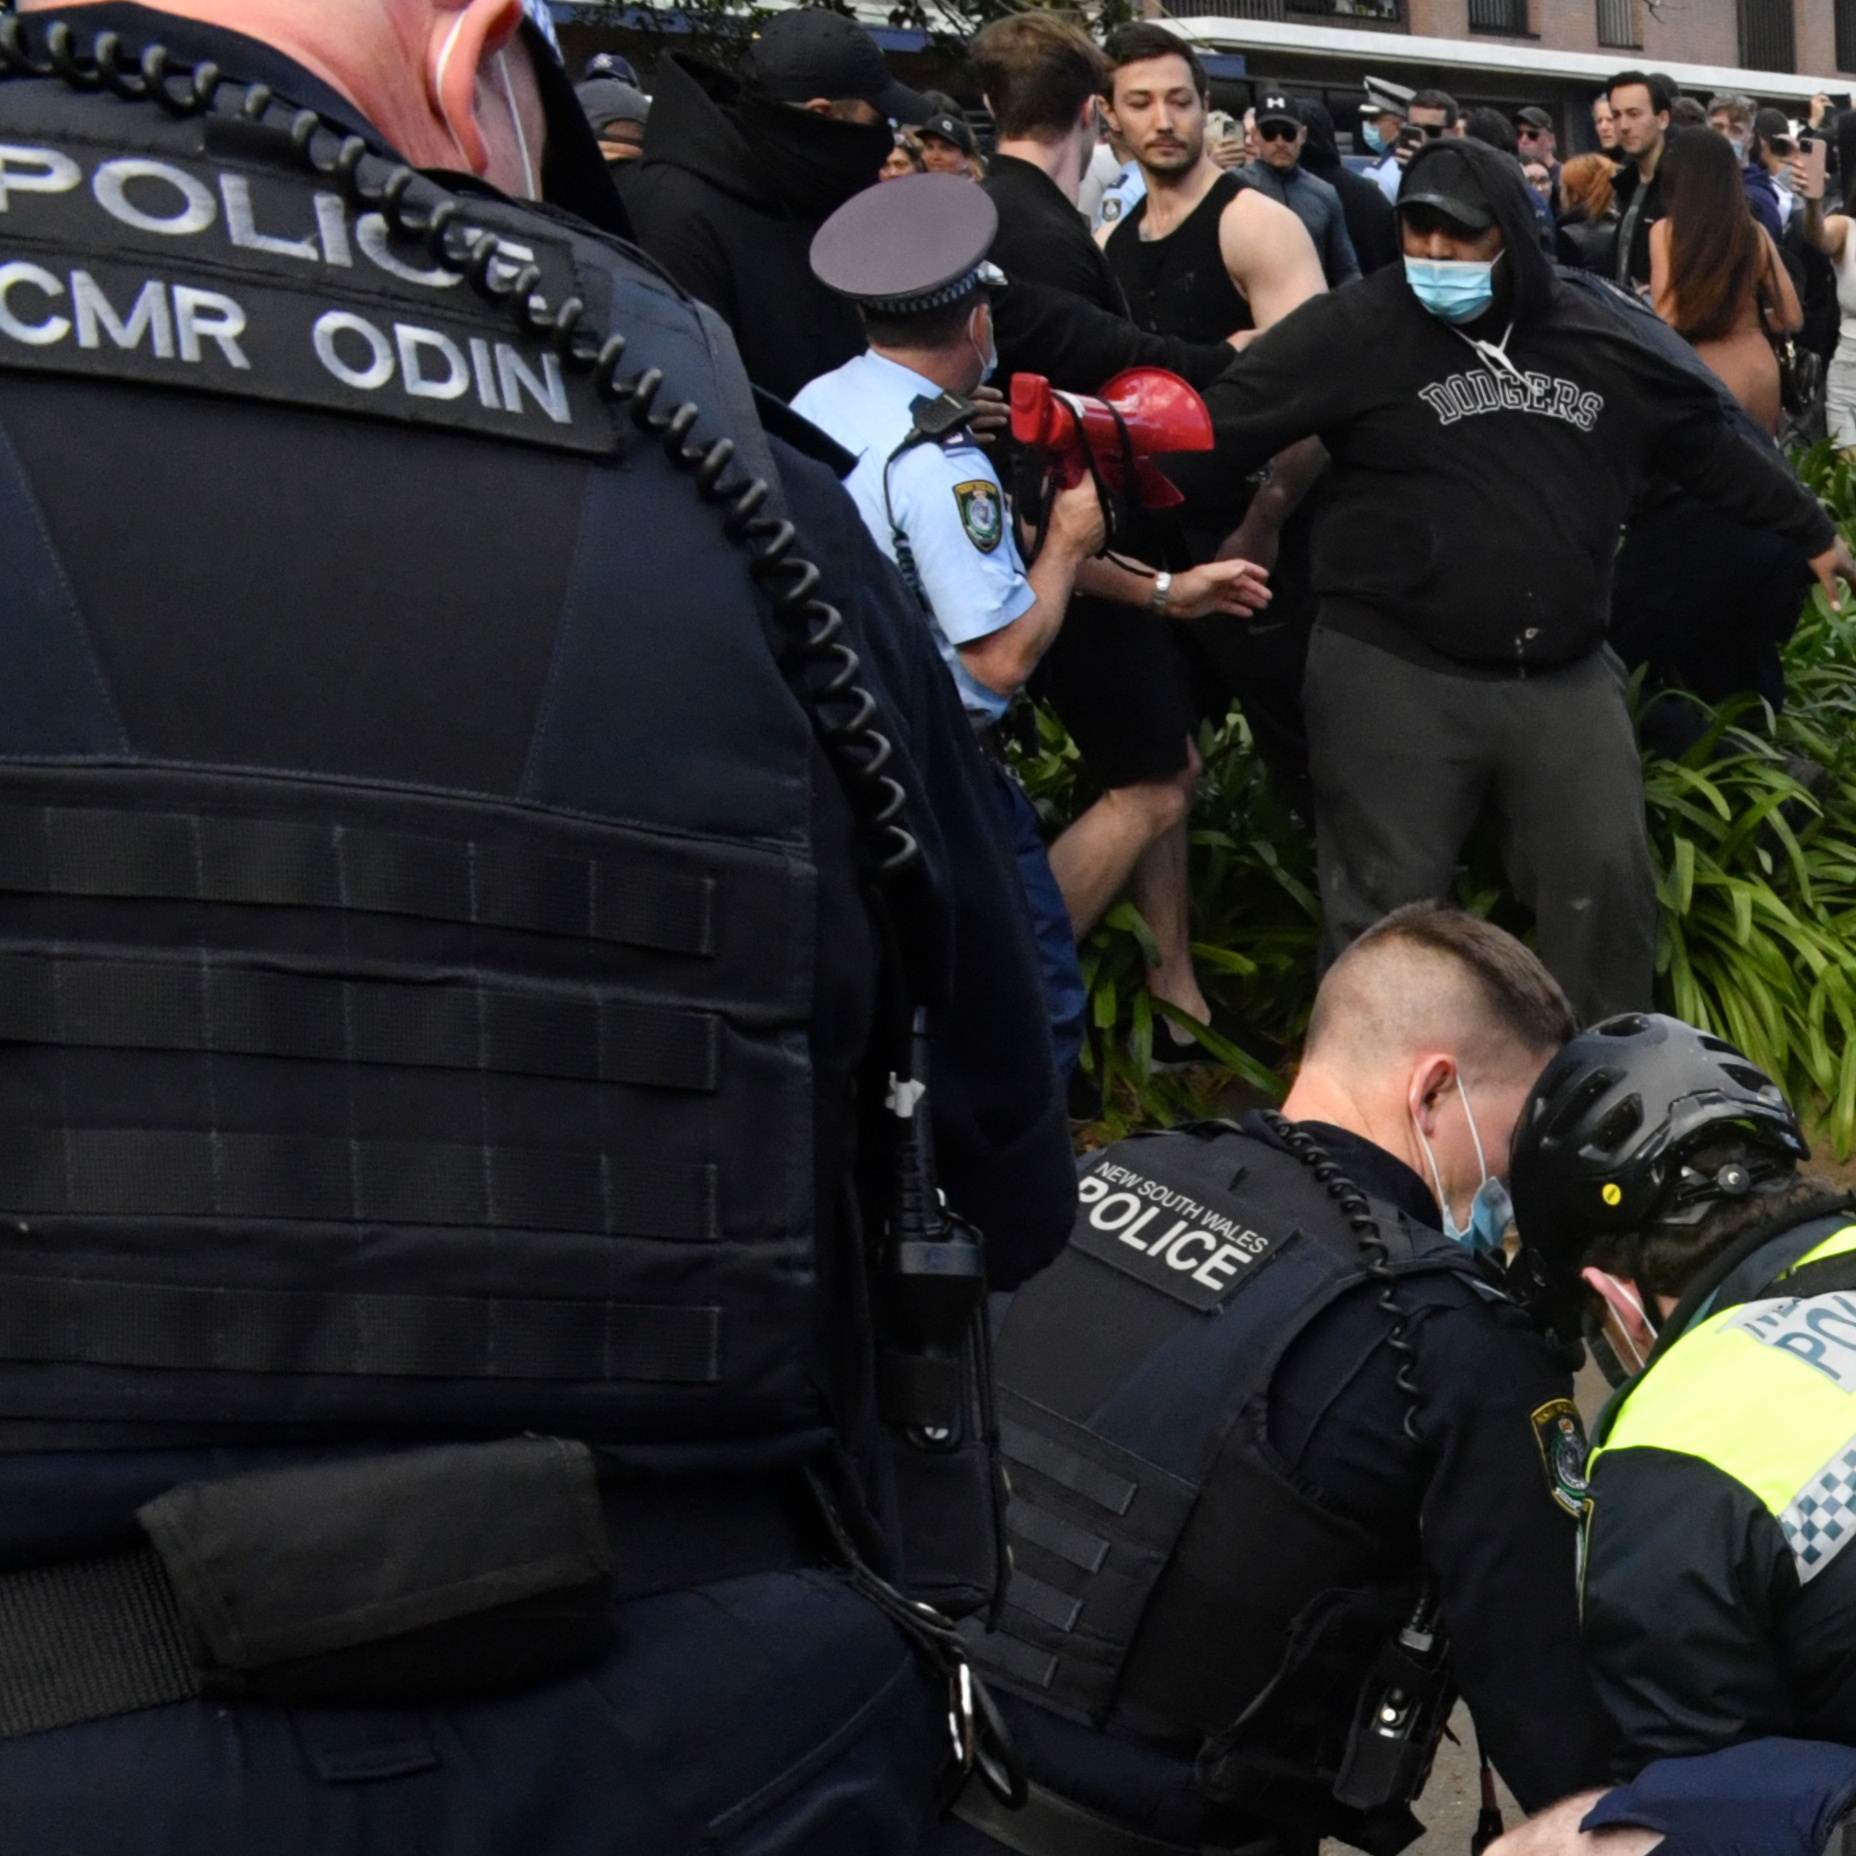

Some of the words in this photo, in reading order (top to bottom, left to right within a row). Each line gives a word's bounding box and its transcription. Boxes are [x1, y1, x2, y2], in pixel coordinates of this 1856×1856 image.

[0, 261, 251, 370] CMR
[313, 310, 573, 424] ODIN
[1418, 369, 1604, 432] DODGERS
[1078, 1176, 1254, 1291] POLICE
[1094, 1161, 1144, 1189] NEW
[1137, 1180, 1205, 1220] SOUTH
[1201, 1209, 1269, 1255] WALES
